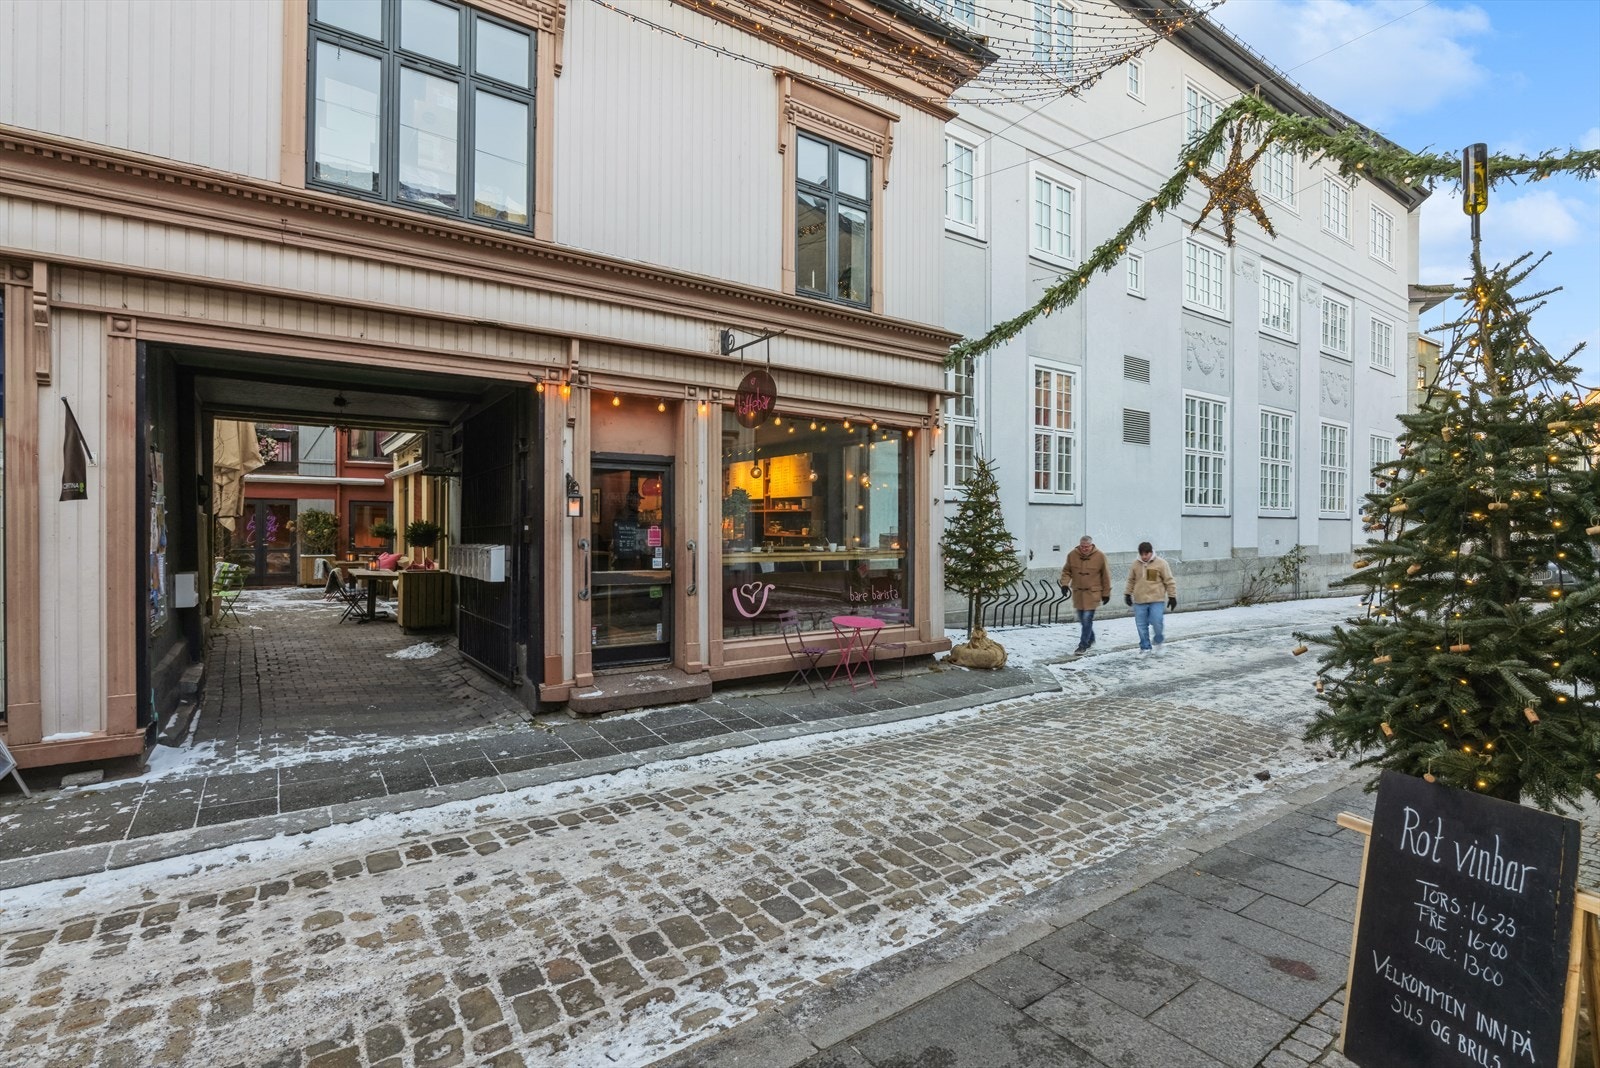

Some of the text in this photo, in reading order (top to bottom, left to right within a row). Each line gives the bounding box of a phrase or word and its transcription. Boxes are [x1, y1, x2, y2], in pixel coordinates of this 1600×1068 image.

[737, 386, 771, 416] kaffebar
[850, 584, 899, 602] bare barista
[1400, 806, 1537, 894] Rot vinbar
[1373, 950, 1536, 1064] VELKOMMEN INN PÅ
[1391, 994, 1501, 1068] SUS OG BRUS
